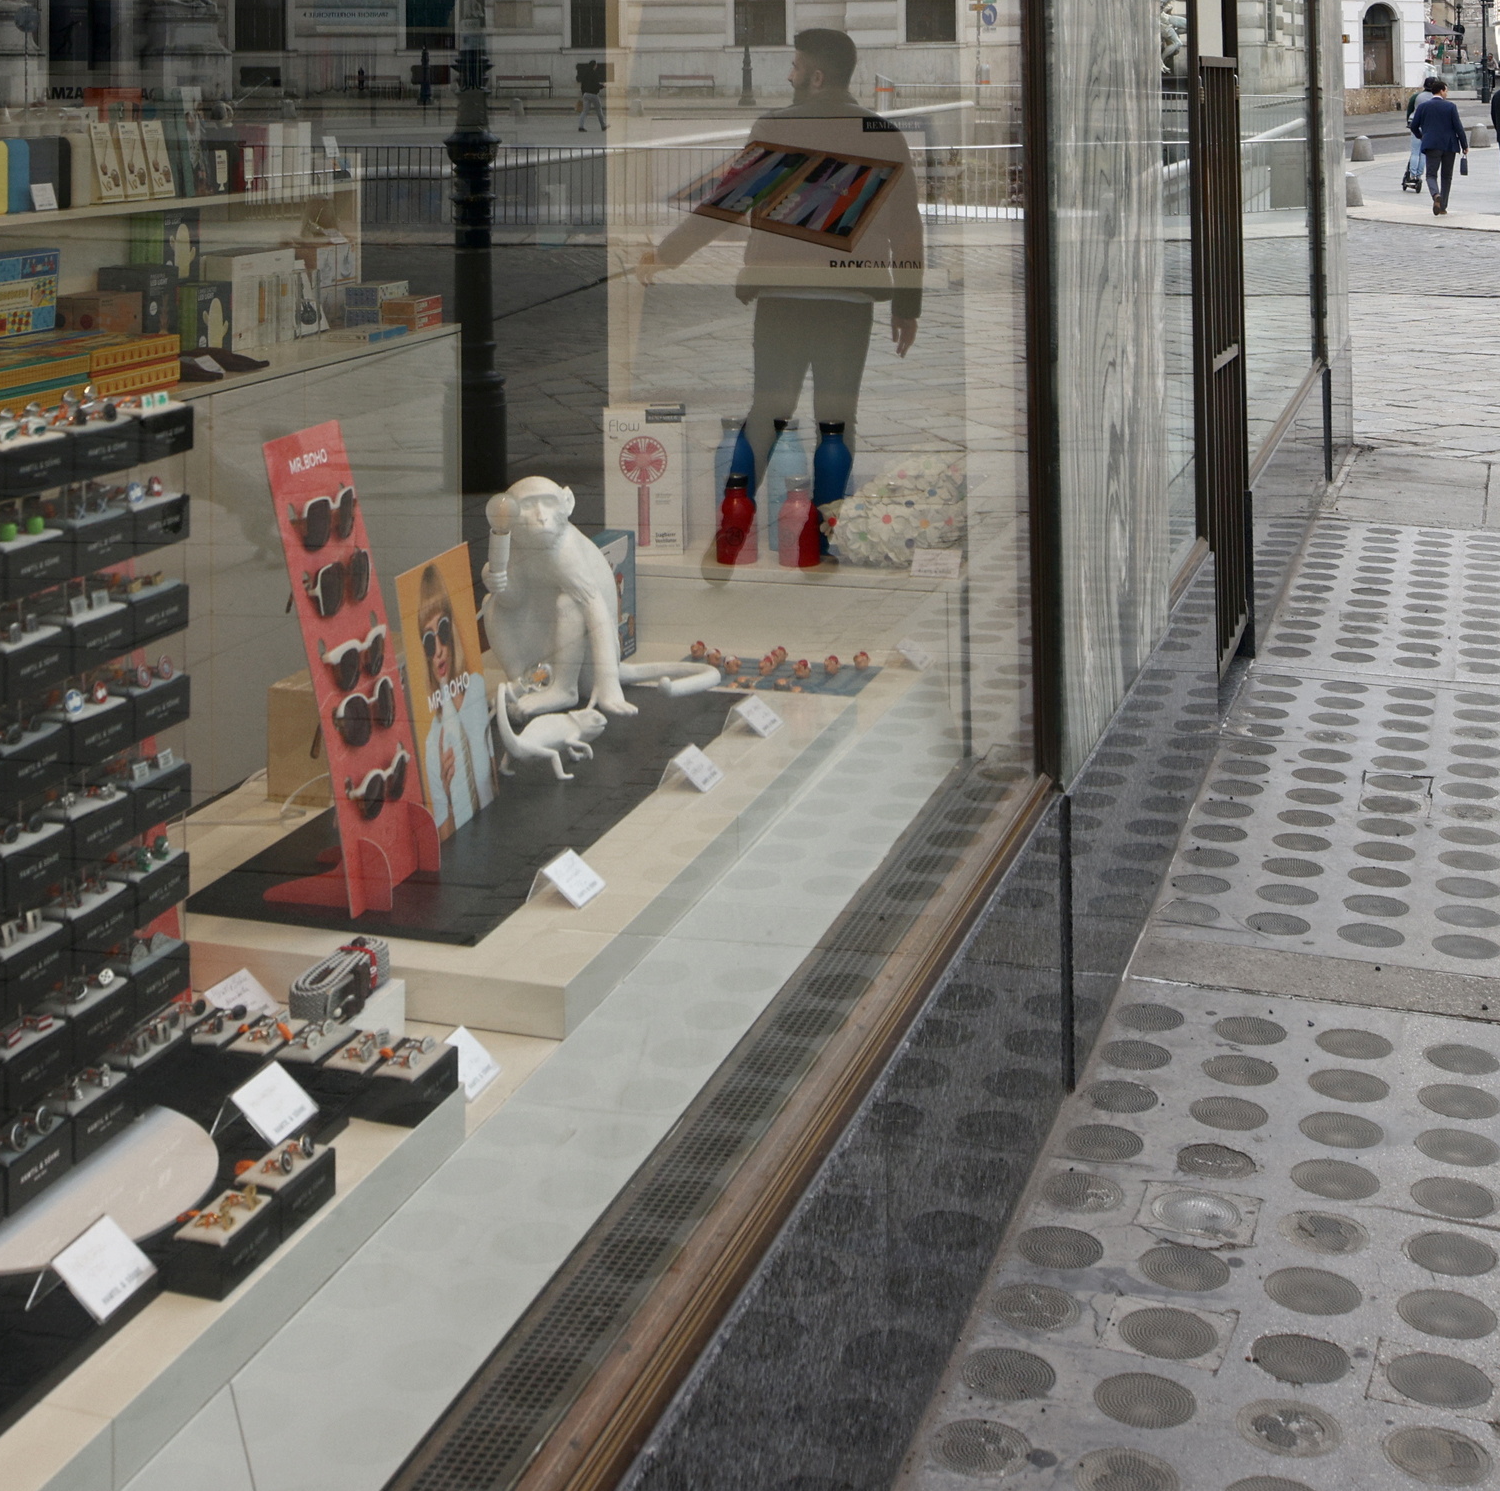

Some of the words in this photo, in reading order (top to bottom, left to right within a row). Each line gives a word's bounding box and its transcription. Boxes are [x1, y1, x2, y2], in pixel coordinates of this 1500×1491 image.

[33, 87, 84, 101] LAMZA
[866, 120, 921, 130] REMEMBER
[608, 418, 640, 433] Flow
